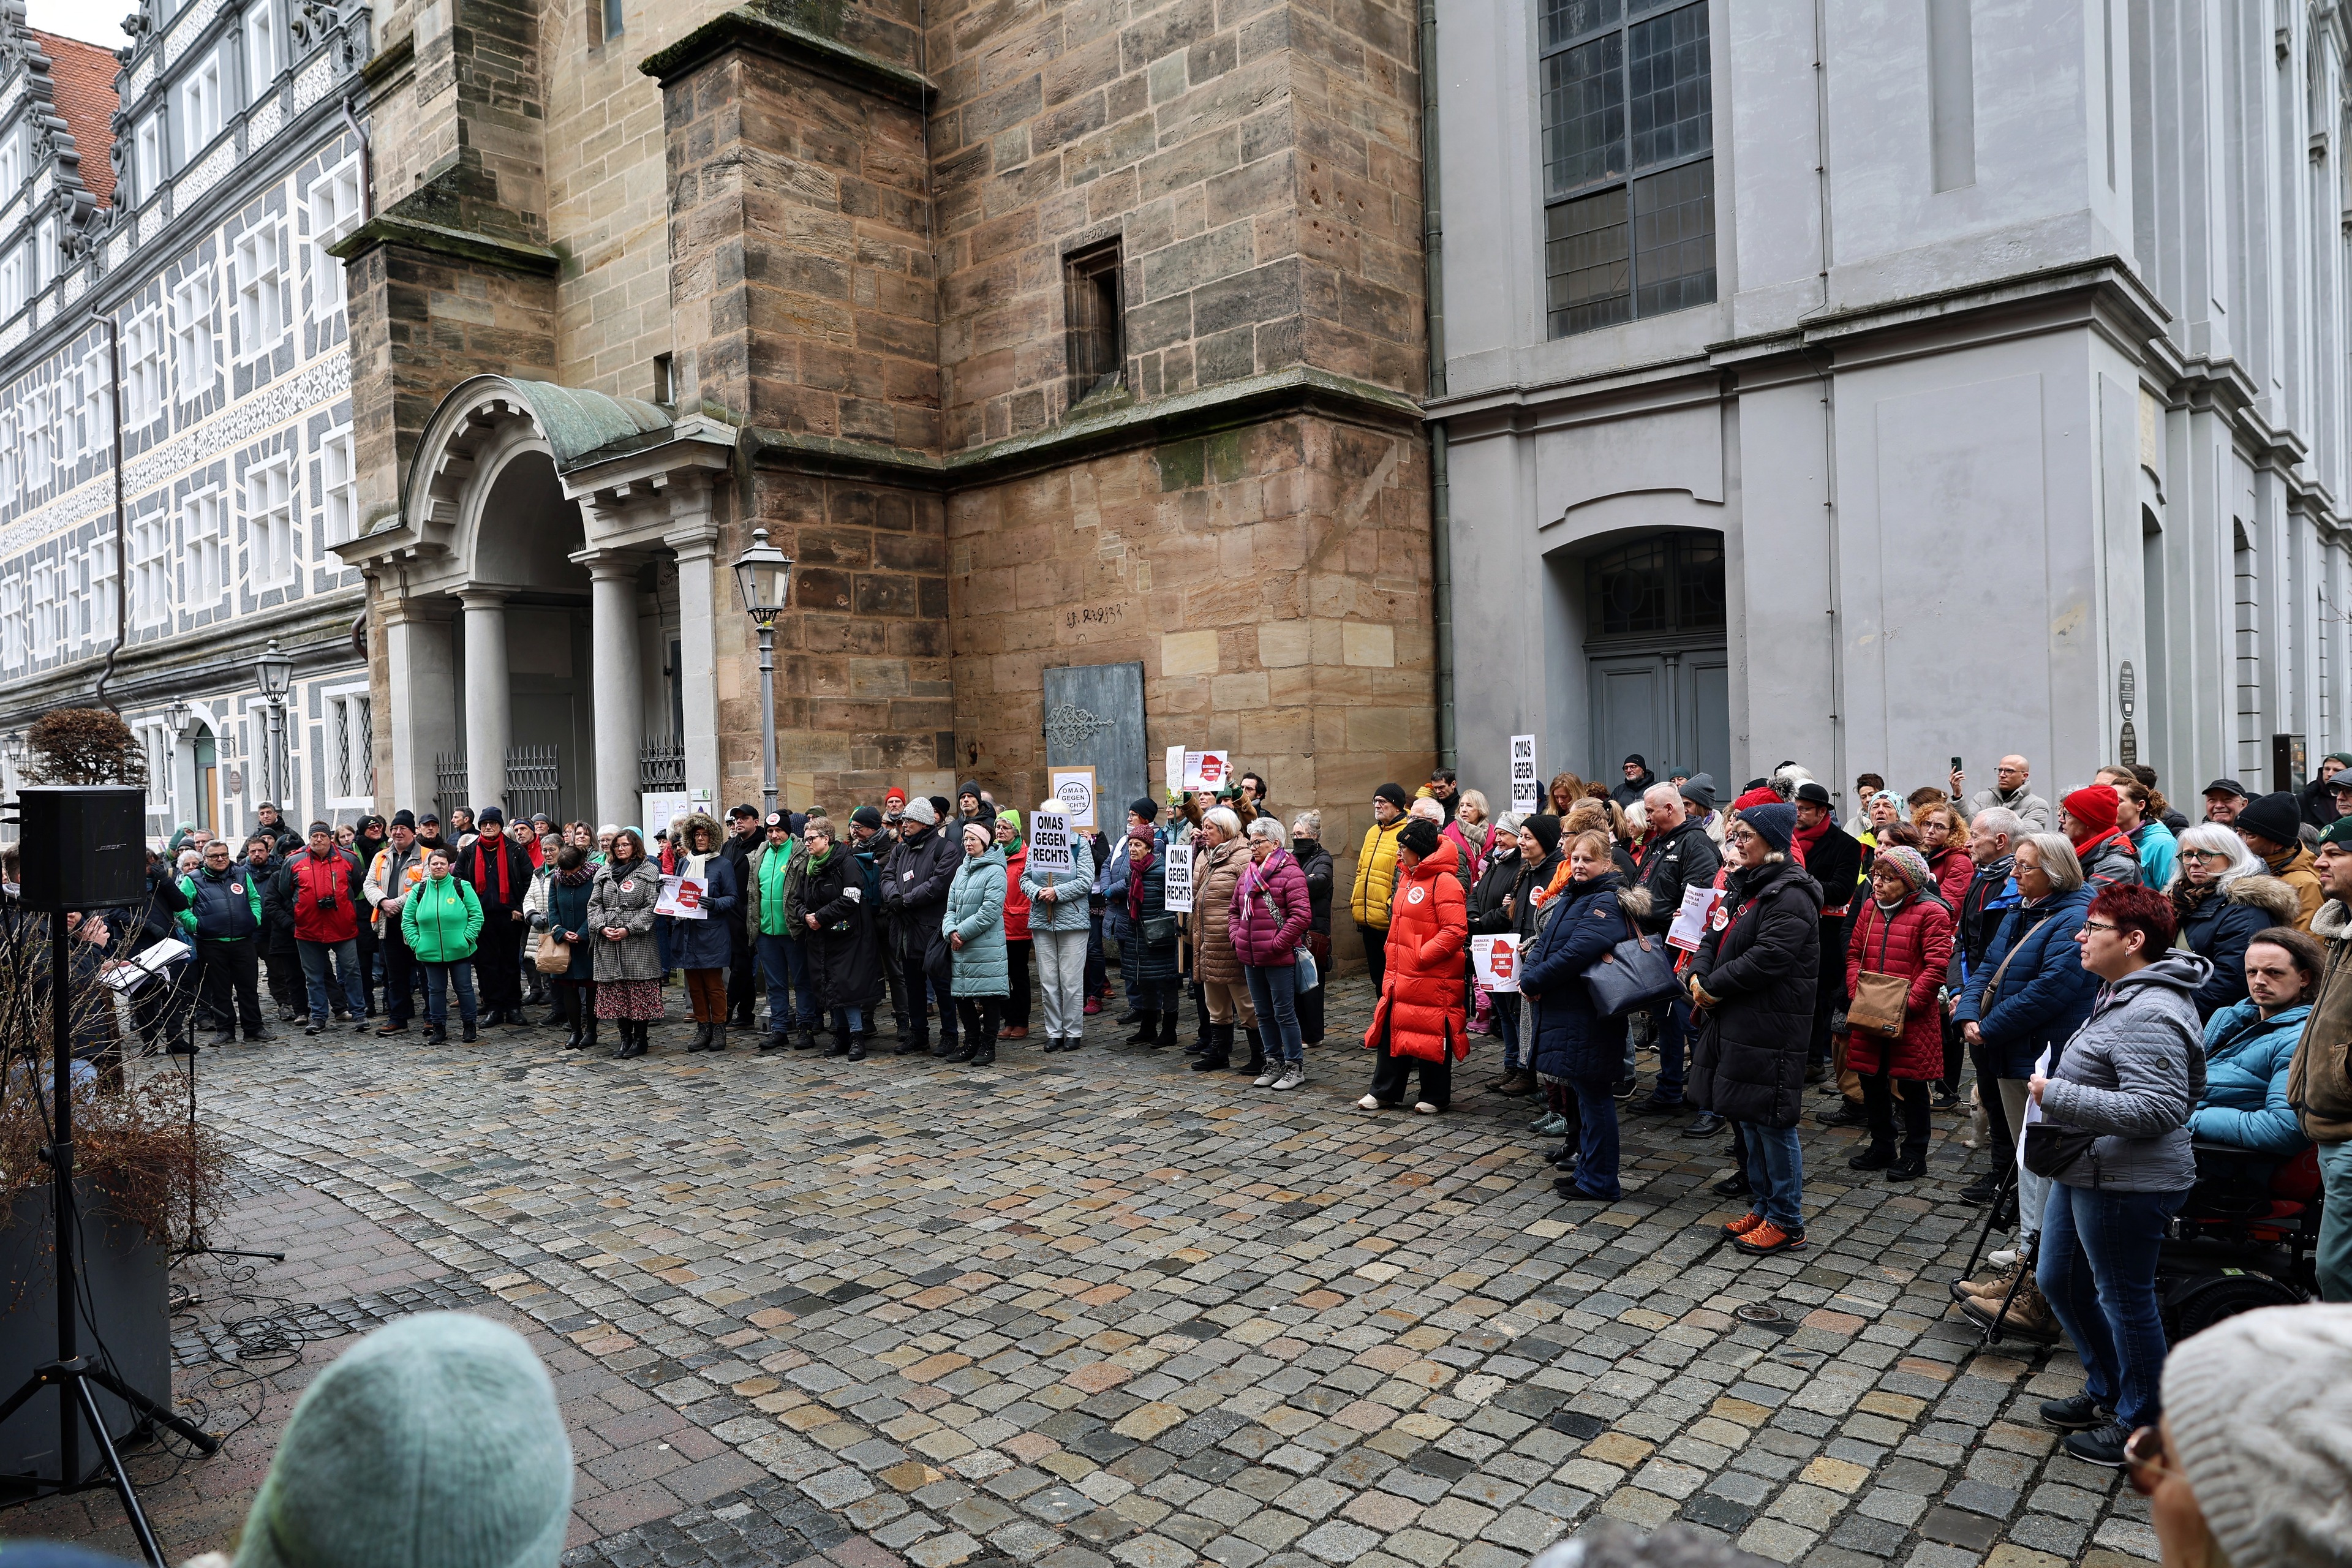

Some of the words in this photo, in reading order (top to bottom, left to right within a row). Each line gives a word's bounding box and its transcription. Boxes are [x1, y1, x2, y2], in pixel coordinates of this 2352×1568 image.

[1515, 740, 1531, 758] OMAS
[1169, 754, 1182, 766] OMAS
[1514, 761, 1534, 779] GEGEN
[1513, 783, 1536, 801] RECHTS
[1038, 815, 1063, 831] OMAS
[1035, 832, 1066, 846] GEGEN
[1033, 848, 1069, 864] RECHTS
[1170, 850, 1188, 864] OMAS
[1169, 867, 1189, 883] GEGEN
[1167, 885, 1191, 901] RECHTS
[1826, 903, 1850, 914] SPD
